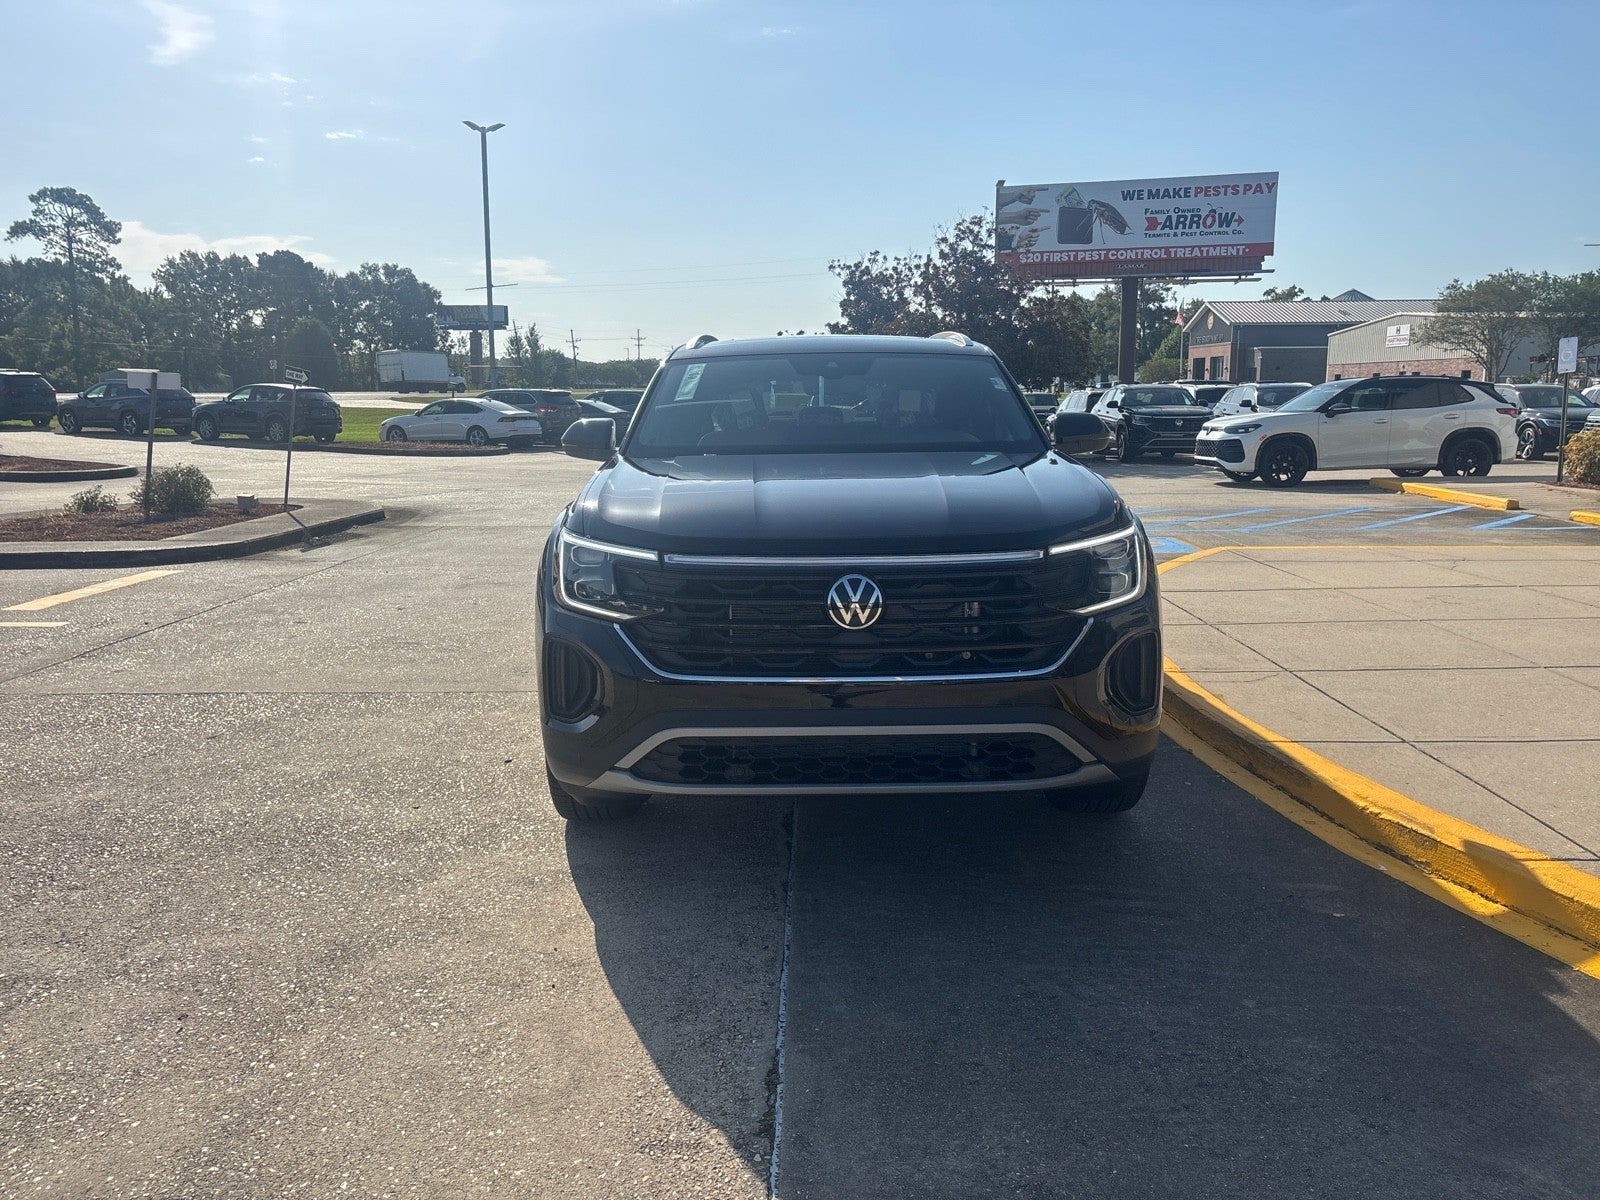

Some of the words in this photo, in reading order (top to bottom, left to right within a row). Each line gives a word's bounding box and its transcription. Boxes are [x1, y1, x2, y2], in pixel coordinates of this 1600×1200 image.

[1121, 189, 1144, 201] WE
[1147, 186, 1191, 200] MAKE
[1194, 184, 1240, 198] PESTS
[1243, 182, 1277, 195] PAY
[1144, 208, 1171, 216] FAMILY
[1160, 210, 1236, 230] ARROW
[1199, 229, 1230, 237] CONTROL
[1019, 252, 1041, 264] $20
[1043, 251, 1076, 262] FIRST
[1077, 250, 1107, 261] PEST
[1108, 248, 1168, 260] CONTROL
[827, 574, 882, 629] VW
